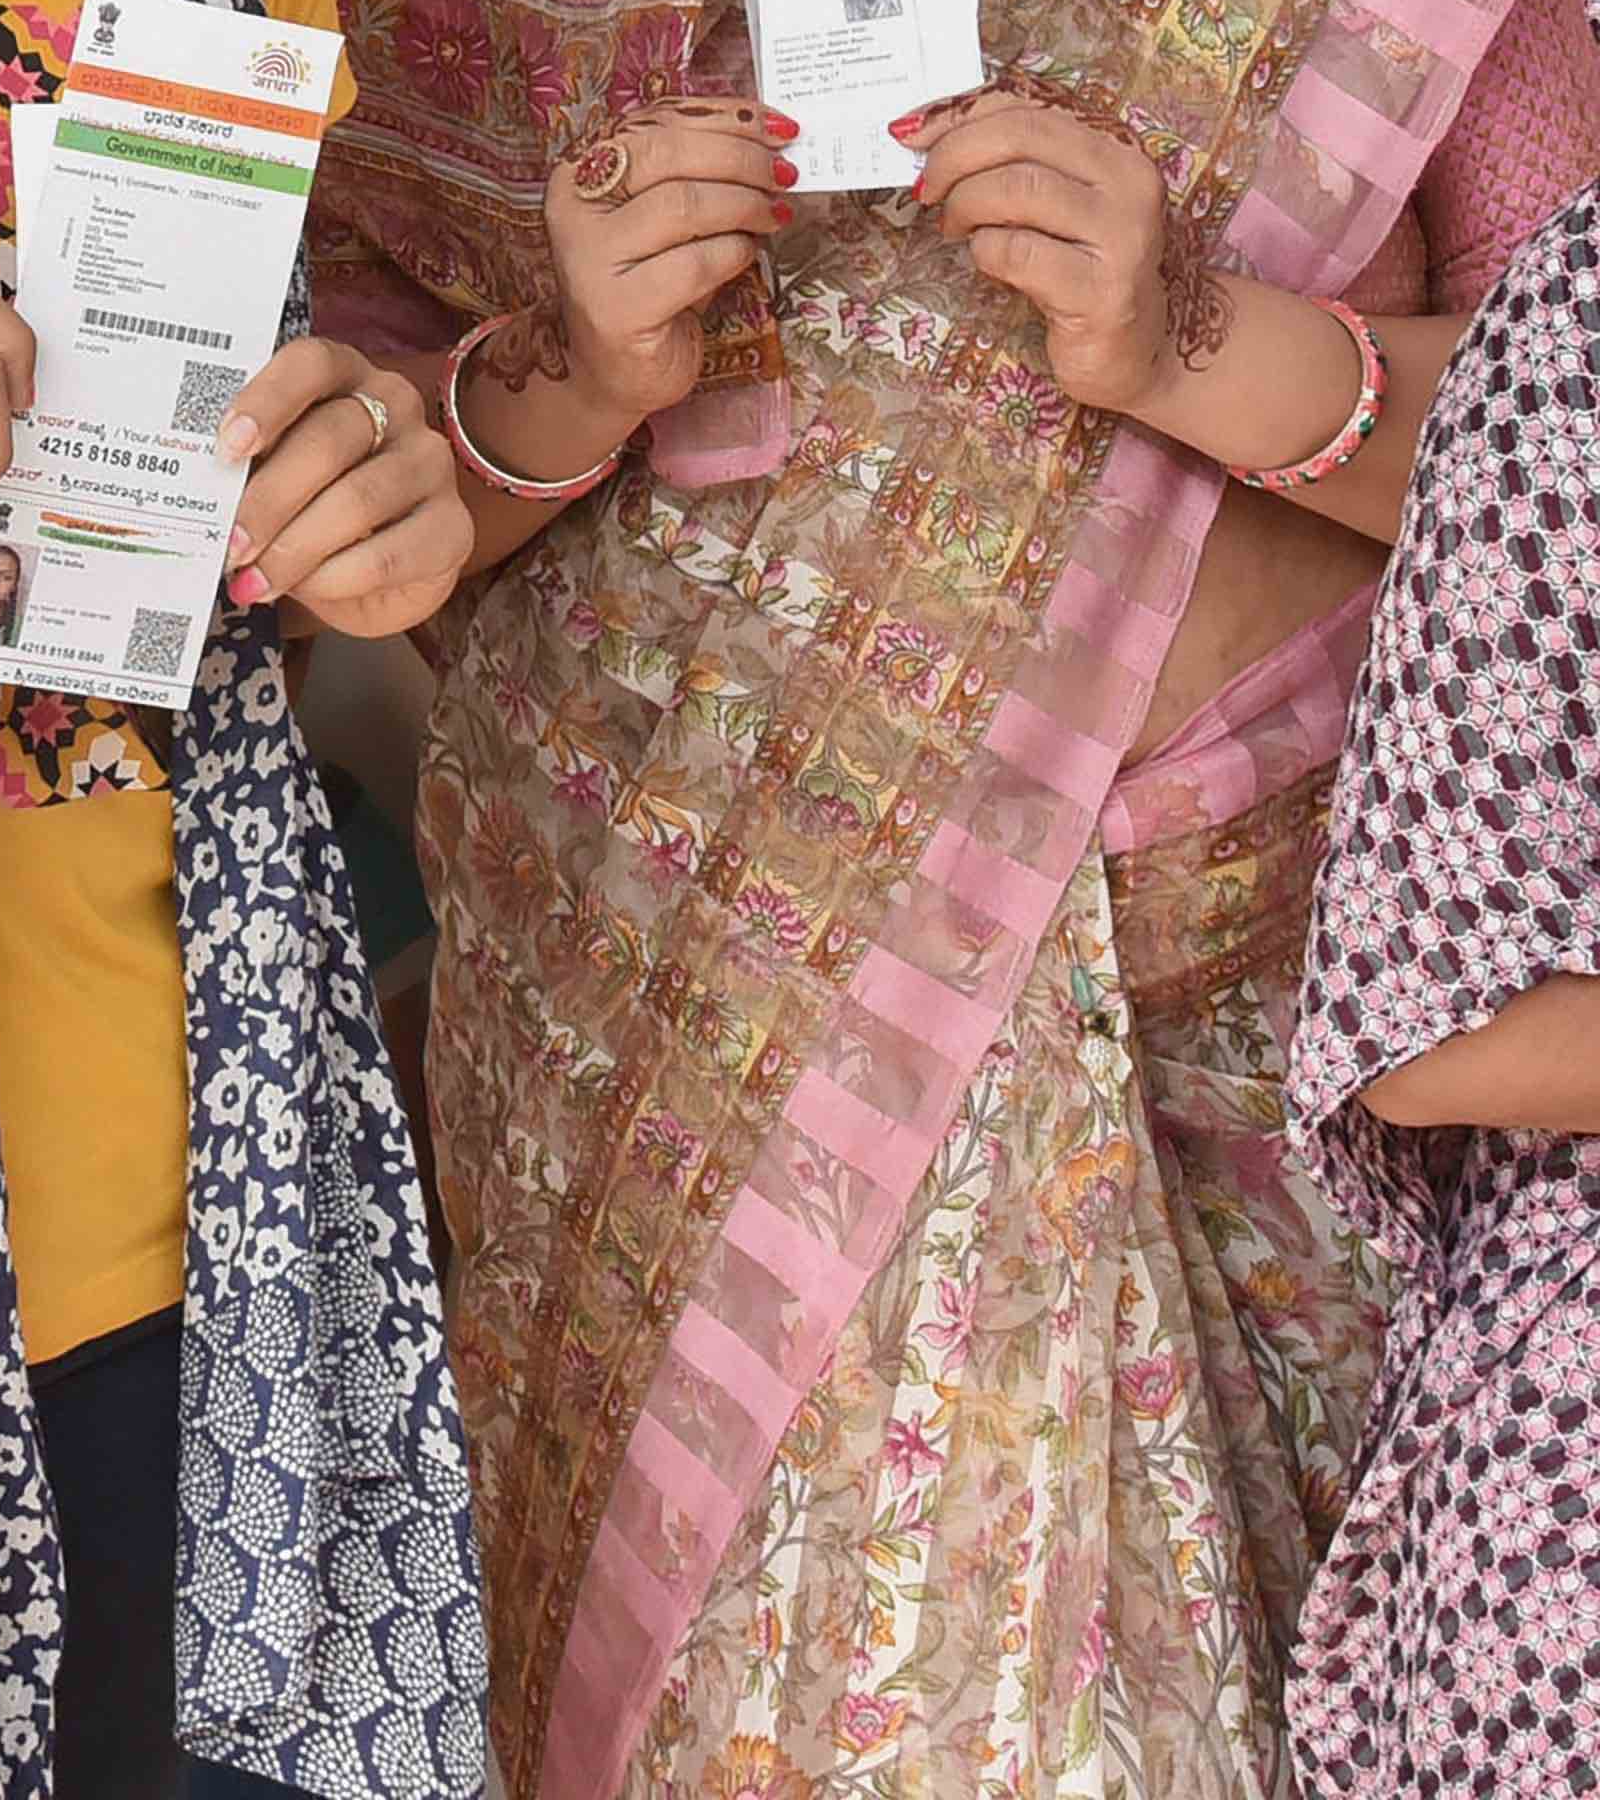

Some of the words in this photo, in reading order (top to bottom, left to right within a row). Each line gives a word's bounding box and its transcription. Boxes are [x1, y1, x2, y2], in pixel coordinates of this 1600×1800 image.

[106, 135, 198, 170] Government
[201, 154, 216, 172] of
[217, 157, 254, 181] India
[38, 436, 84, 459] 4215
[87, 444, 132, 468] 8158
[136, 453, 180, 476] 8840
[122, 428, 151, 443] Your
[152, 434, 201, 453] Aadhaar
[2, 465, 43, 482] ಧಾರ್
